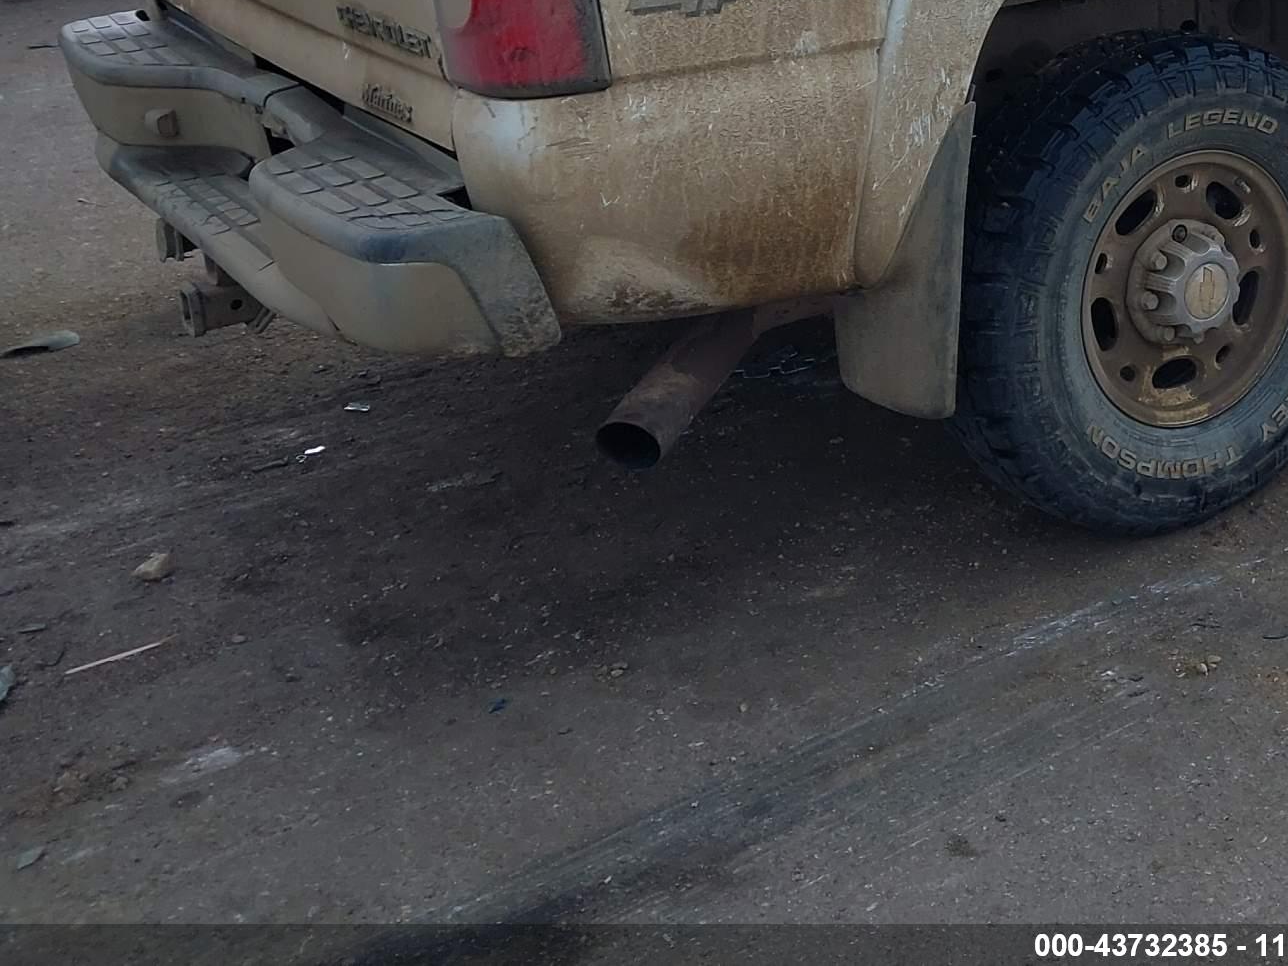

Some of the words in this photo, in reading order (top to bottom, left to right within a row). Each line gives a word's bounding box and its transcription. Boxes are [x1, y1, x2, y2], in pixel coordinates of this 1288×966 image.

[1082, 142, 1150, 223] BAJA
[1166, 108, 1279, 139] LEGEND
[1085, 425, 1244, 480] THOMPSON
